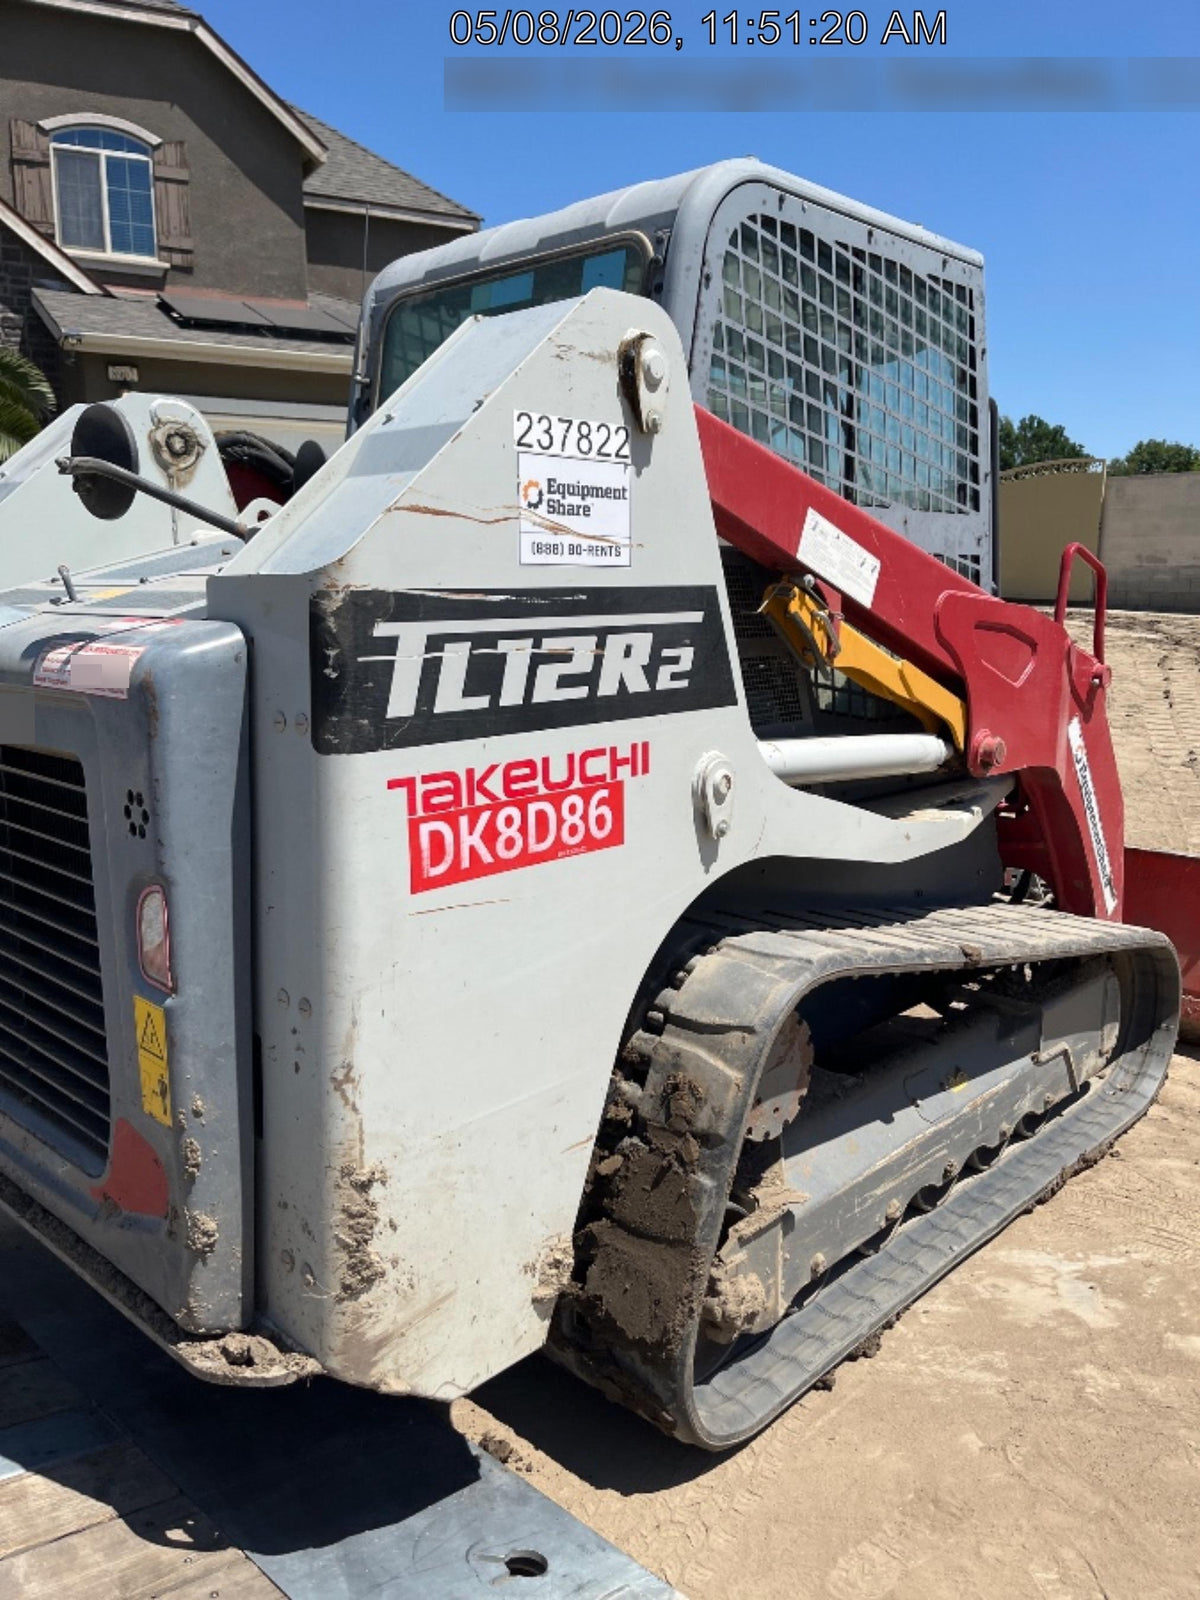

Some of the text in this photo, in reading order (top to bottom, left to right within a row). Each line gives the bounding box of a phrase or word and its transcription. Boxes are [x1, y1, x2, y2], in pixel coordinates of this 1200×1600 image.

[516, 412, 630, 459] 237822
[546, 478, 628, 500] Equipment
[546, 499, 592, 517] Share
[418, 789, 613, 879] DK8D86
